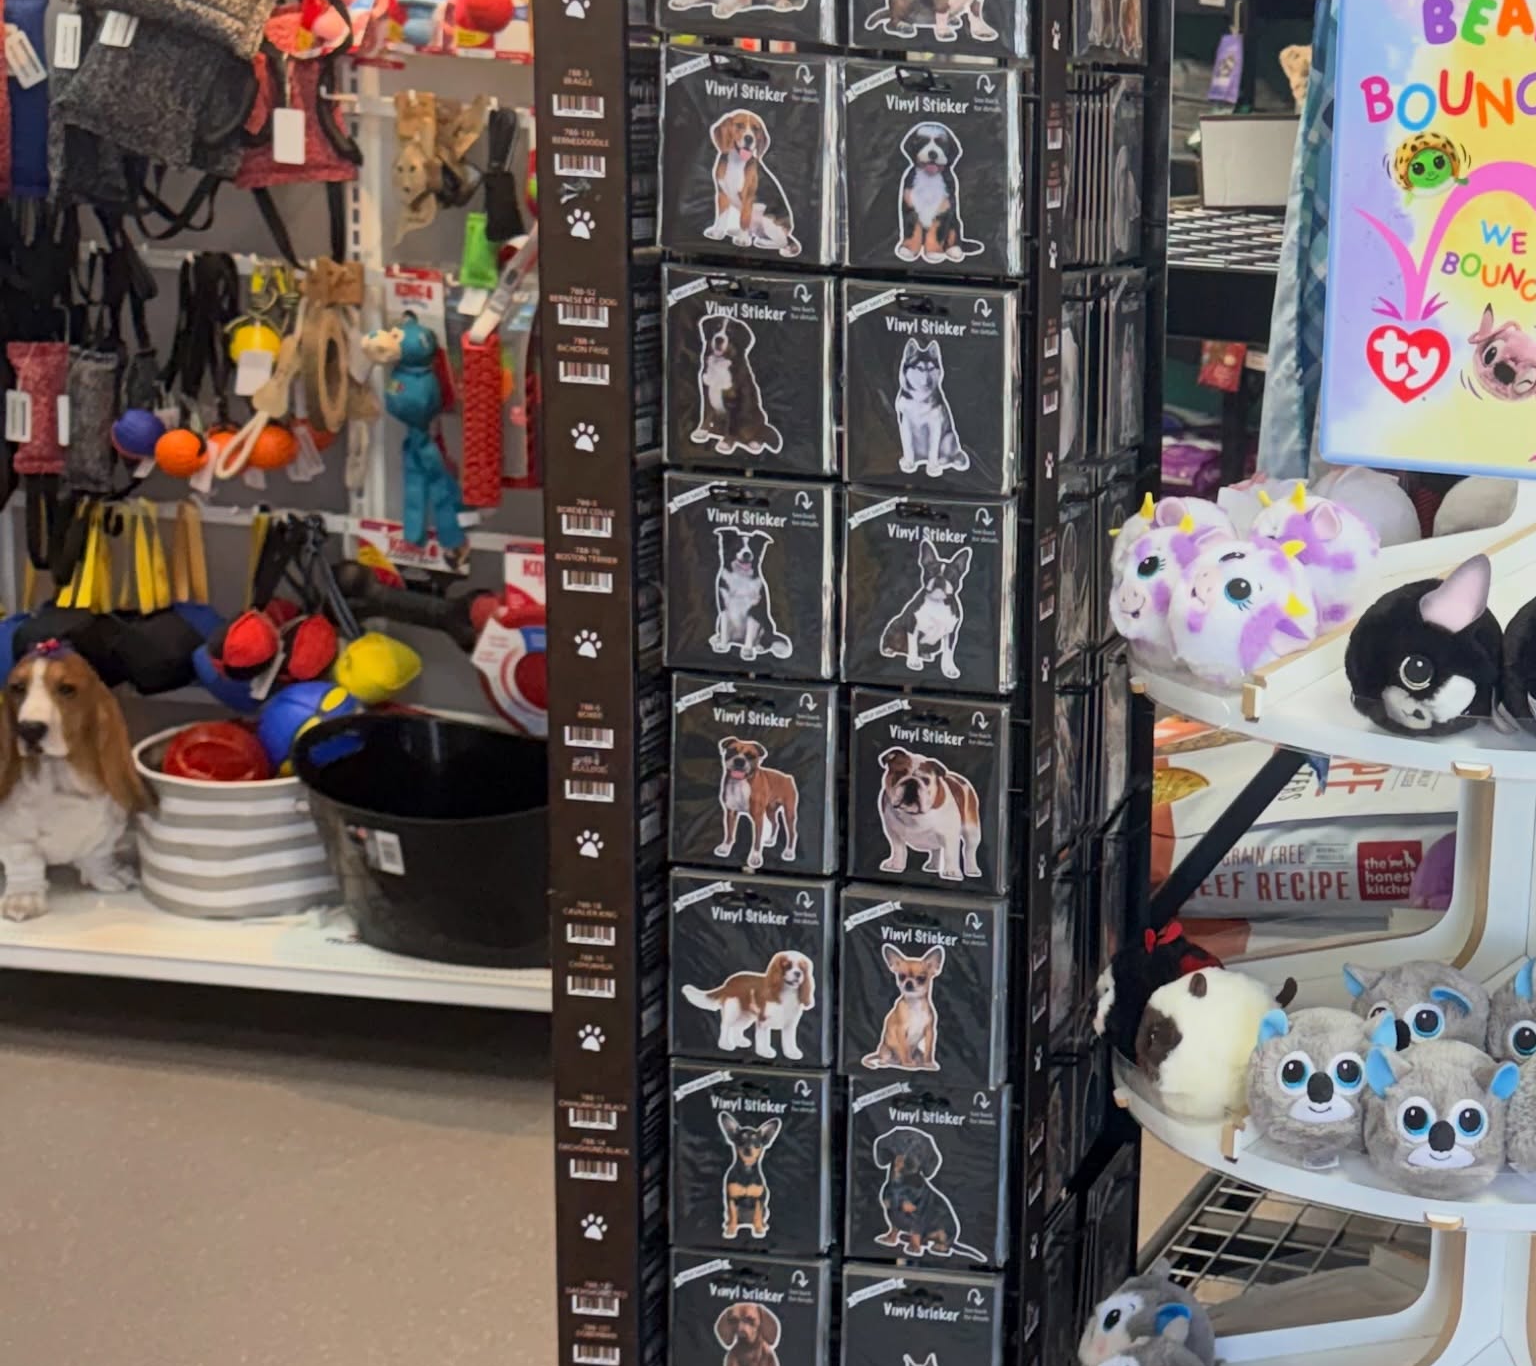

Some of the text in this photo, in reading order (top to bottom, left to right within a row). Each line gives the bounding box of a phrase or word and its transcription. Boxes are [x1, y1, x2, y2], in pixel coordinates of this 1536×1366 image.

[705, 79, 787, 104] Vinyl Sticker
[886, 94, 920, 114] Vinyl
[922, 97, 970, 115] Sticker
[1480, 220, 1528, 255] WE
[740, 303, 787, 322] Sticker
[886, 316, 966, 336] Vinyl Sticker
[1372, 335, 1440, 392] ty
[706, 506, 787, 528] Vinyl Sticker
[887, 522, 967, 545] Vinyl Sticker
[712, 706, 791, 729] Vinyl Sticker
[889, 724, 965, 746] Vinyl Sticker
[1270, 843, 1307, 866] FREE
[1364, 857, 1388, 870] the
[1190, 870, 1351, 903] EEF RECIPE
[1364, 870, 1415, 883] honest
[711, 905, 789, 927] Vinyl Sticker
